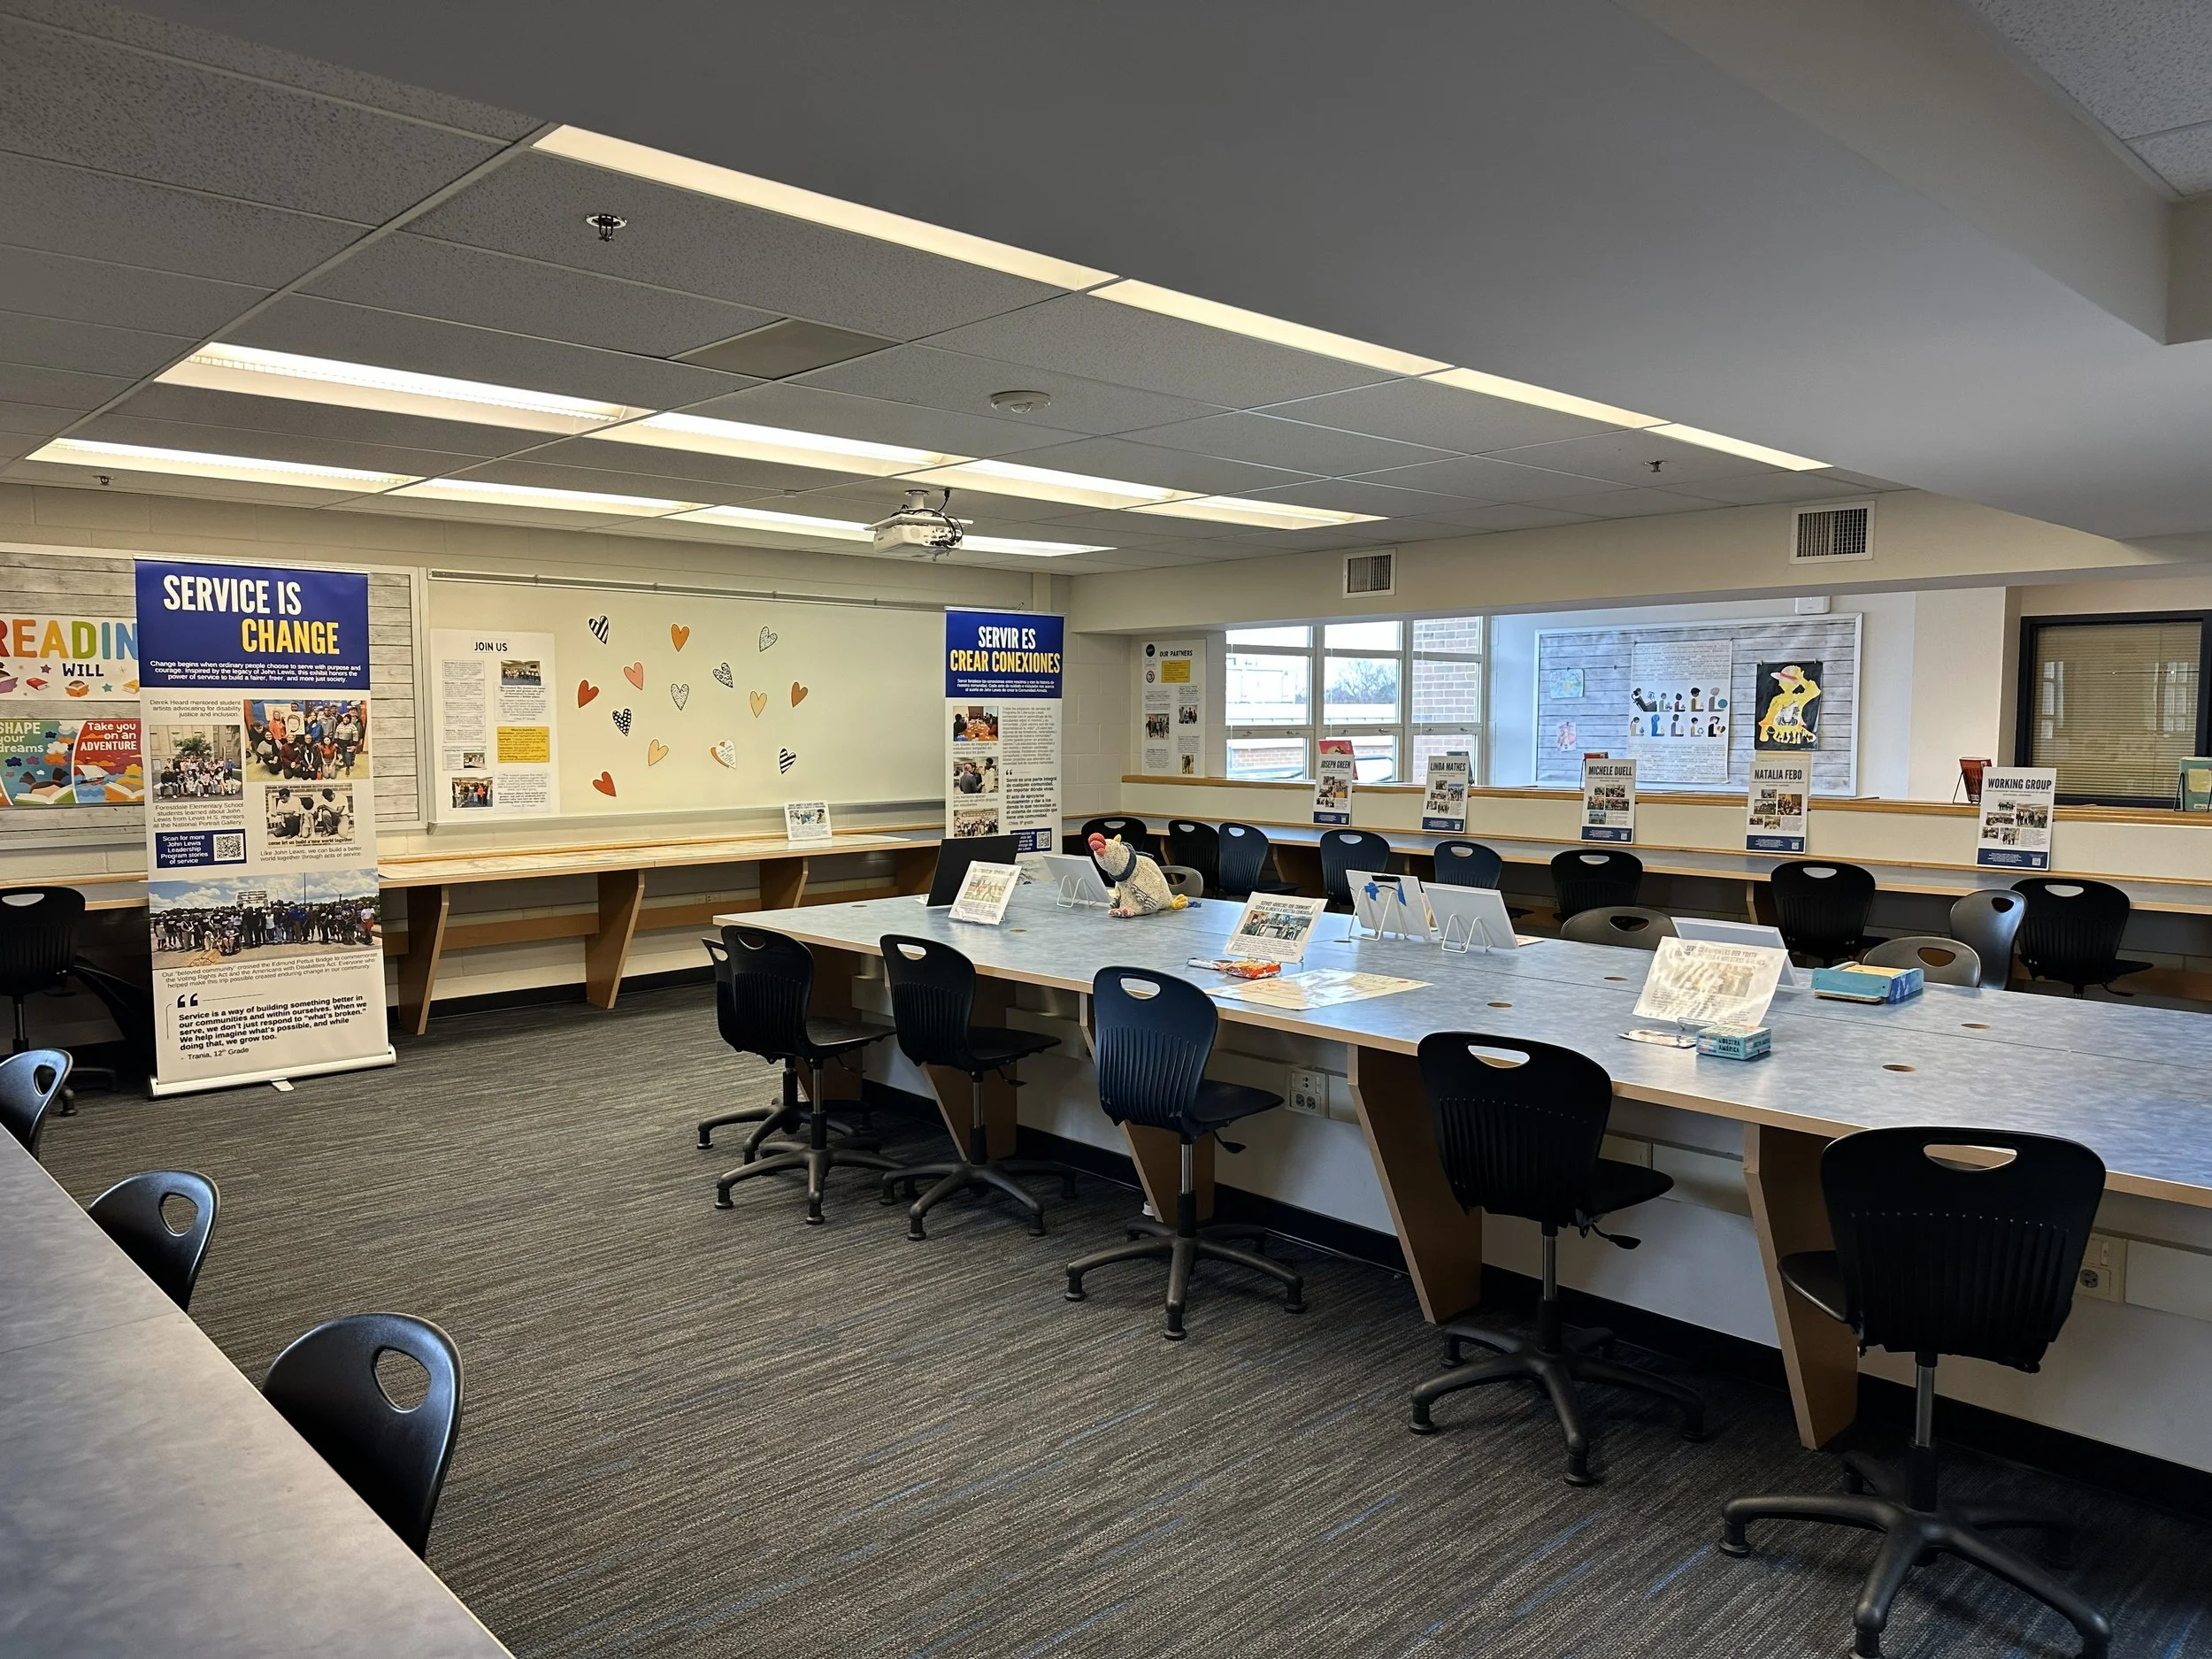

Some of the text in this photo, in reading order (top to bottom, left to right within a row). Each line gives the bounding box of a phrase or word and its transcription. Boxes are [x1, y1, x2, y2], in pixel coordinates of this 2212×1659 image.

[163, 574, 302, 615] SERVICE IS
[242, 618, 340, 655] CHANGE
[978, 626, 1036, 649] SERVIR ES
[474, 641, 508, 651] JOIN US
[949, 649, 1060, 673] CREAR CONEXIONES
[62, 664, 104, 676] WILL
[0, 722, 41, 734] SHAPE
[88, 722, 136, 733] Take you
[81, 741, 136, 751] ADVENTURE
[1321, 760, 1351, 769] JOSEPH GREEN
[1430, 762, 1466, 772] LINDA MATHES
[1588, 766, 1632, 776] MICHELE DUELL
[1755, 769, 1802, 780] NATALIA FEBO
[1988, 778, 2052, 790] WORKING GROUP
[257, 1003, 288, 1012] building
[290, 998, 330, 1008] something
[196, 1015, 247, 1026] communities
[292, 1006, 331, 1015] ourselves.
[221, 1022, 241, 1031] don't
[243, 1020, 258, 1030] just
[261, 1016, 292, 1026] respond
[196, 1033, 212, 1041] help
[216, 1030, 246, 1039] imagine
[250, 1025, 274, 1034] what's
[277, 1022, 311, 1033] possible,
[240, 1036, 259, 1045] grow
